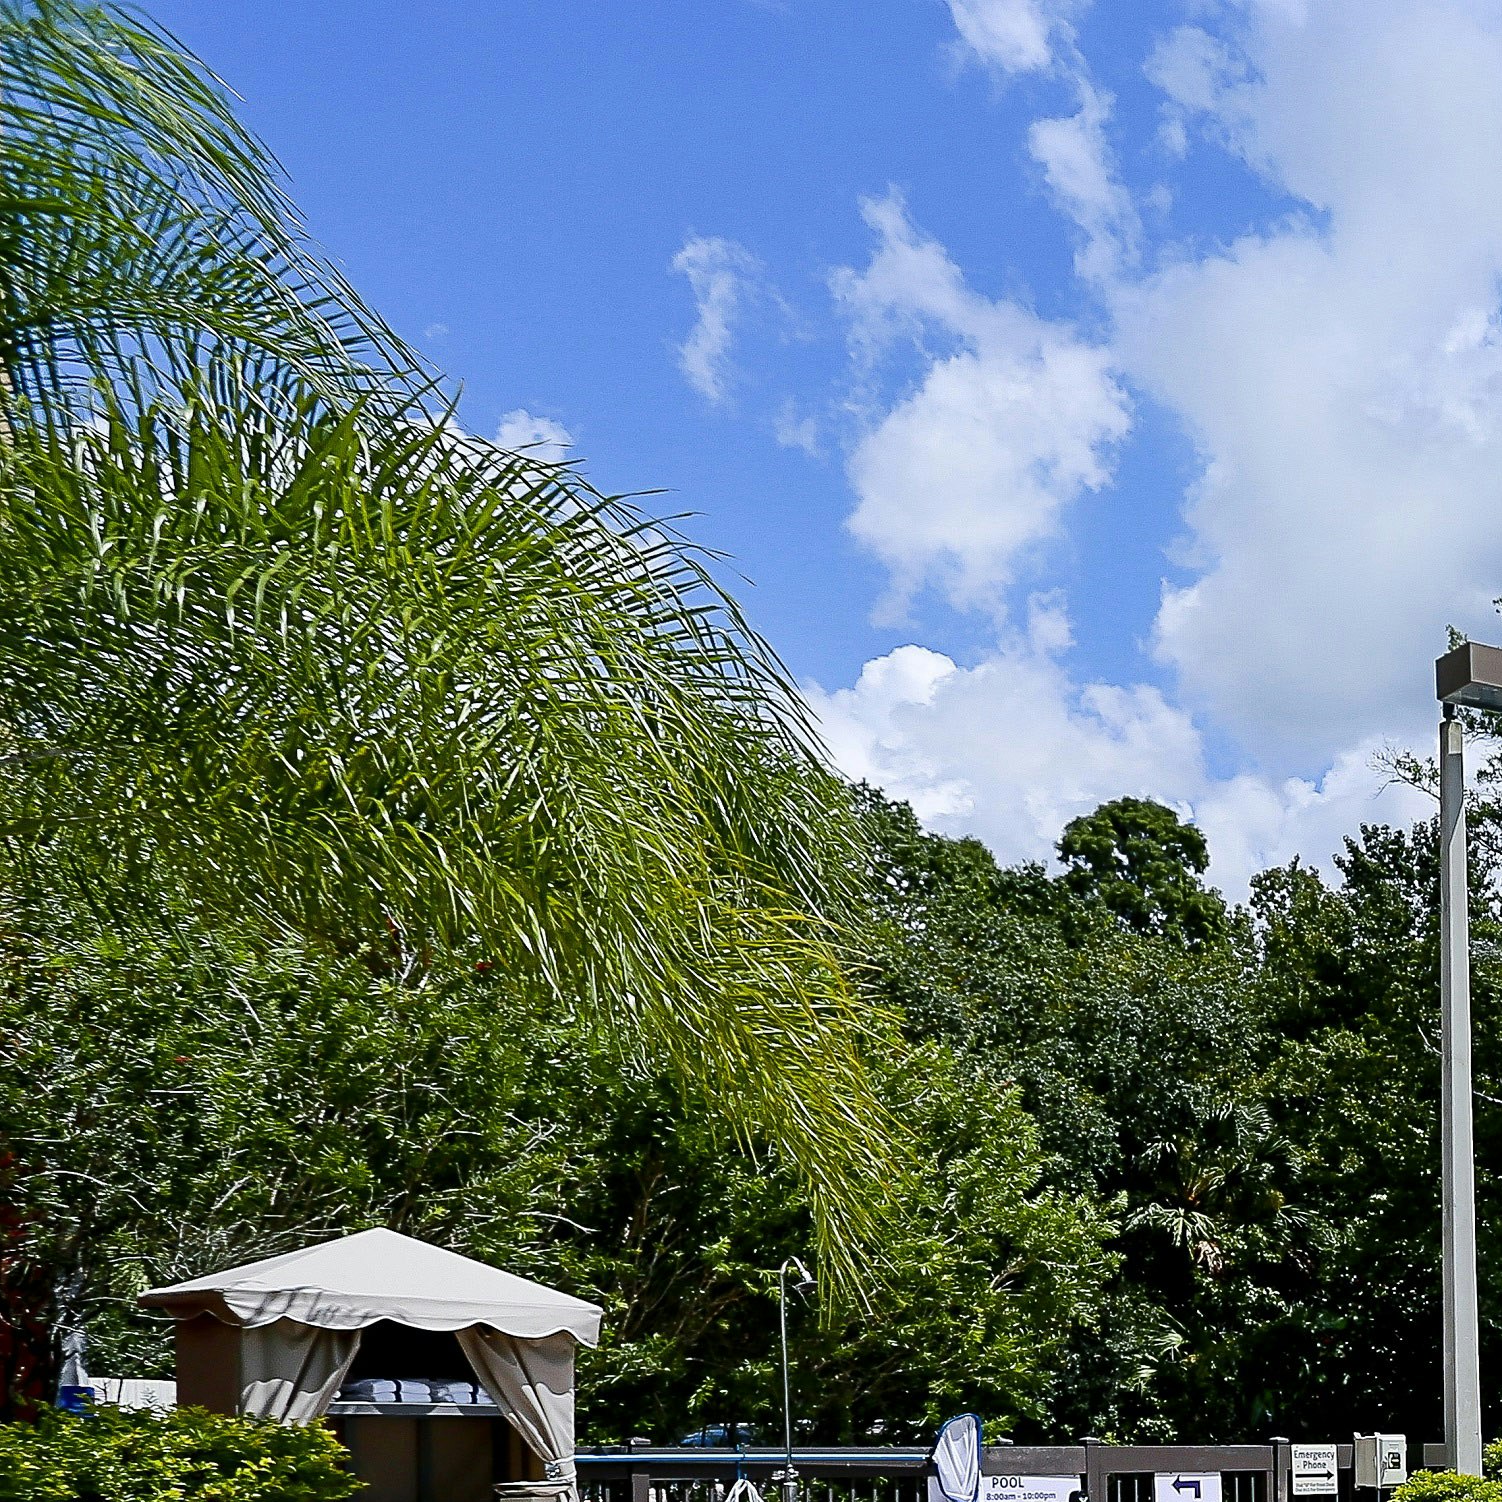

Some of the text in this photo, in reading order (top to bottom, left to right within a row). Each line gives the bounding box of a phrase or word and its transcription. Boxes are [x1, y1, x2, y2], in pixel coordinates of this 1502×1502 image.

[1294, 1450, 1335, 1461] Emergency
[1303, 1461, 1327, 1469] Phone
[992, 1477, 1025, 1488] POOL
[986, 1493, 1016, 1501] 8:00am
[1023, 1492, 1056, 1501] 10:00pm
